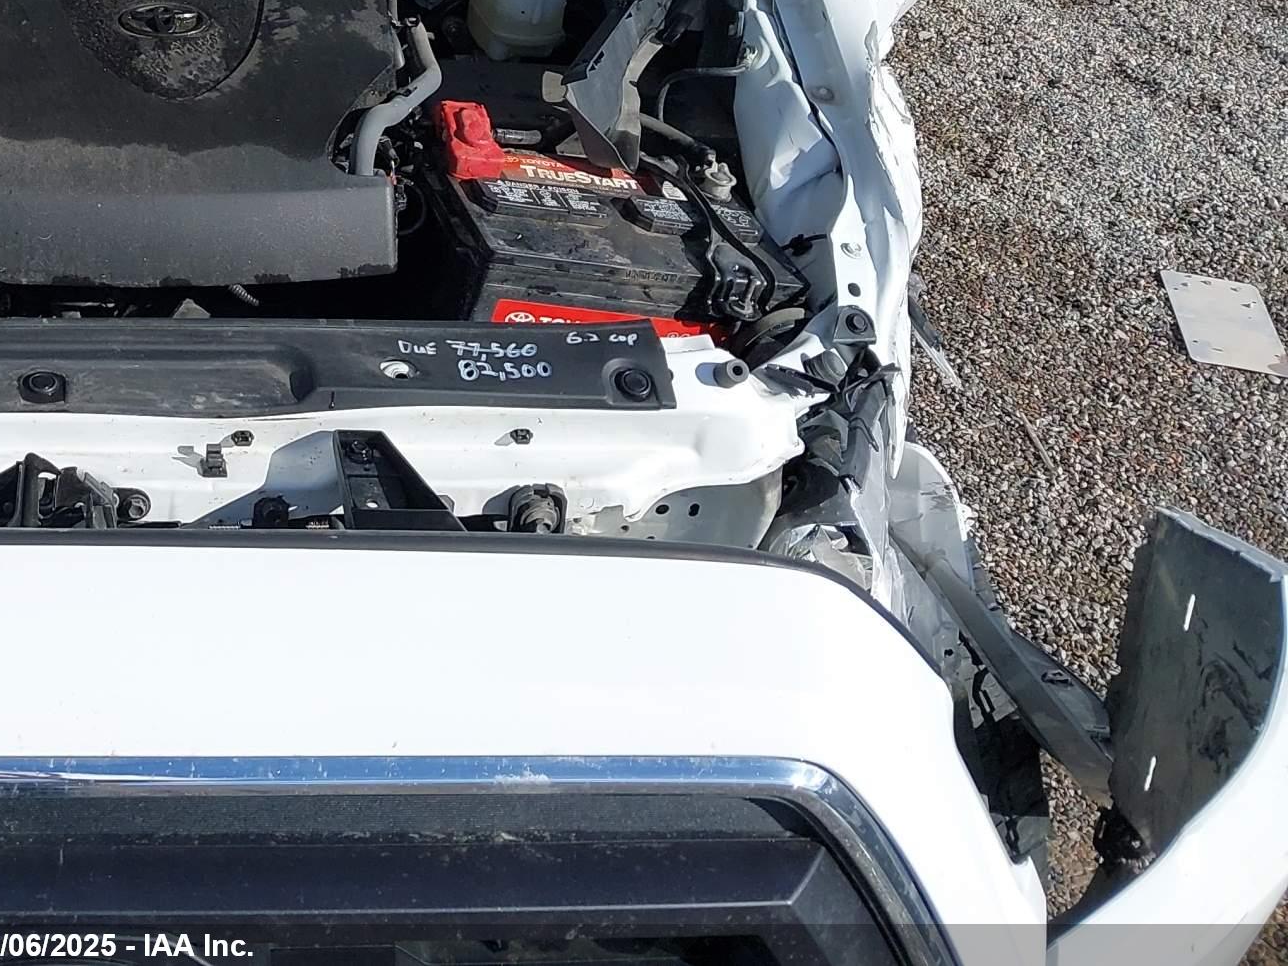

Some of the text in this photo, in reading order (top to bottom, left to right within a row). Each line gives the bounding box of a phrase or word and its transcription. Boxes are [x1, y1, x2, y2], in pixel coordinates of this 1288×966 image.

[520, 158, 564, 168] TOYOTA
[520, 165, 638, 190] TRUESTART
[458, 359, 552, 381] 82,500
